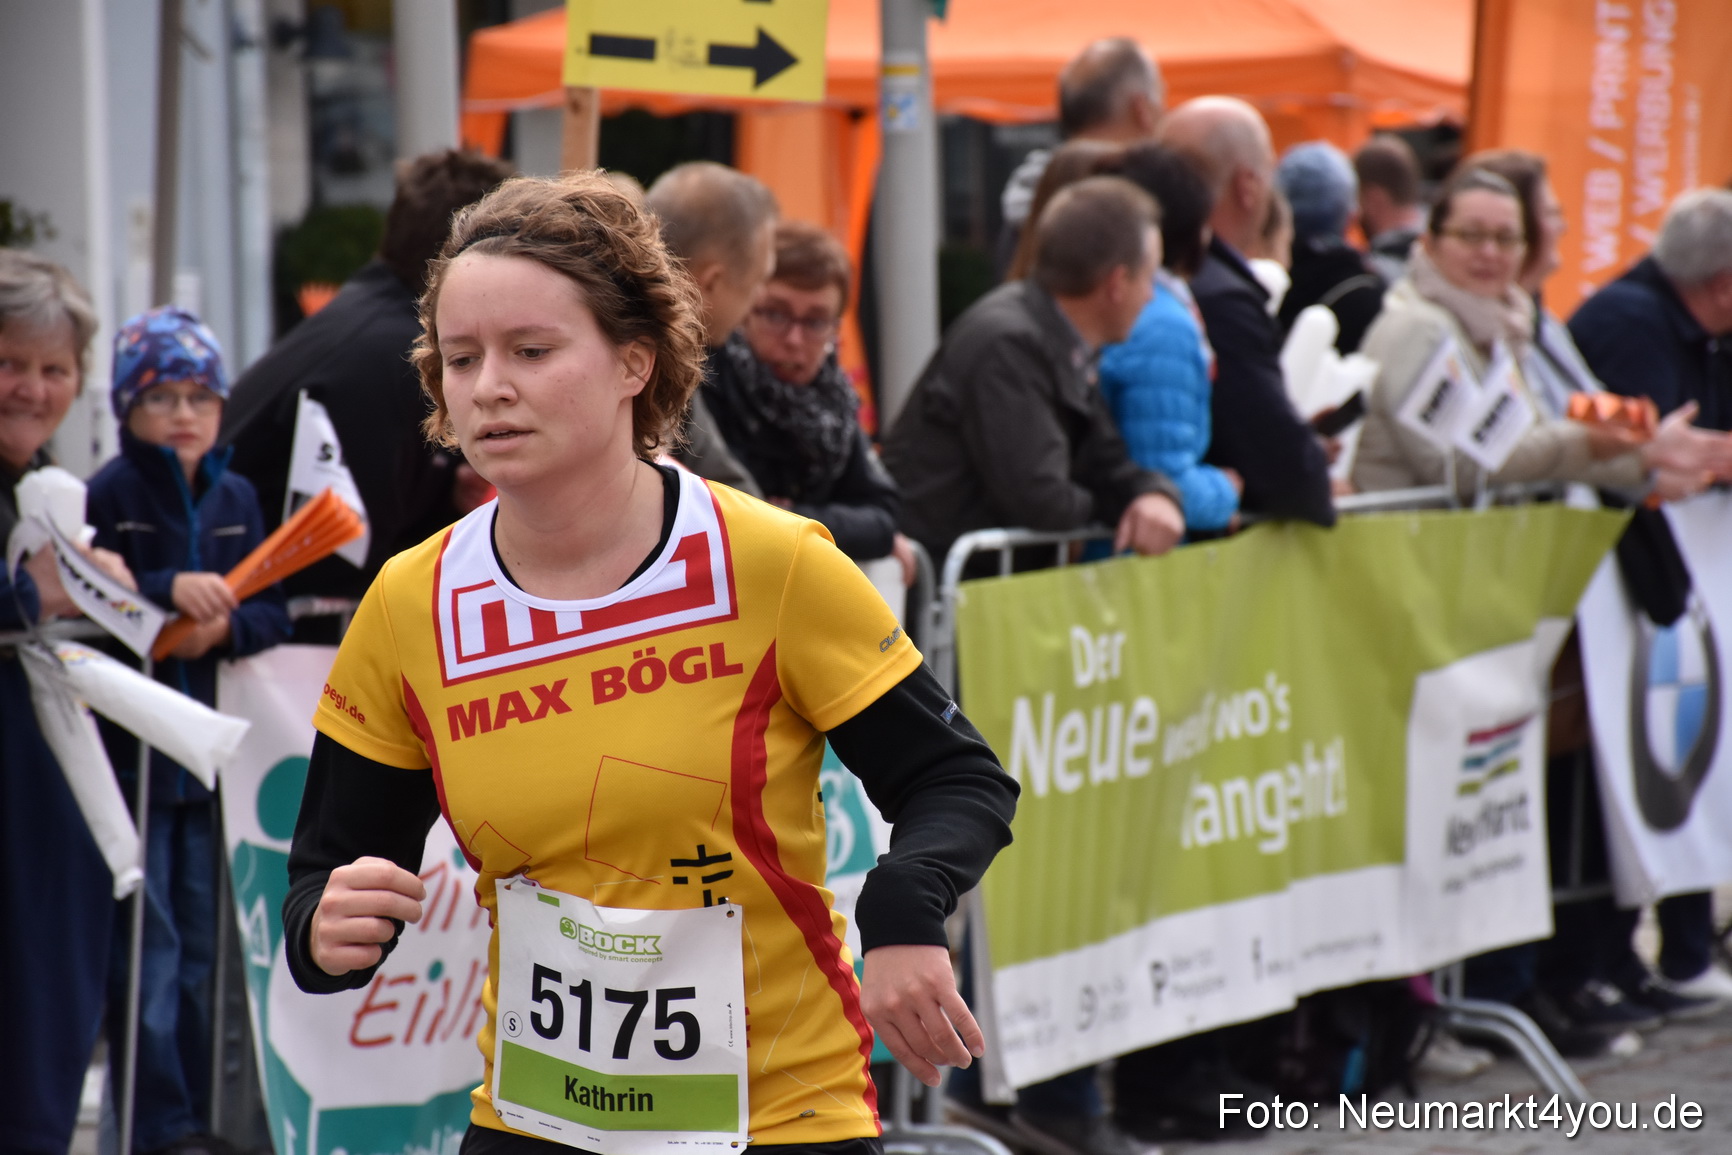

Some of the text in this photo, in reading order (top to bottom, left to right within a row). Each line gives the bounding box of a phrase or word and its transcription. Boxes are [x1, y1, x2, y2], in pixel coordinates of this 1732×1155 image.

[1581, 168, 1624, 274] WEB
[1069, 623, 1127, 688] Der
[323, 683, 366, 725] oegl.de
[446, 642, 744, 742] MAX BÖGL
[1007, 692, 1159, 798] Neue
[578, 923, 663, 956] BOCK
[608, 955, 629, 963] smart
[630, 956, 663, 964] concepts
[508, 1017, 517, 1032] S
[529, 962, 701, 1061] 5175
[564, 1074, 654, 1112] Kathrin
